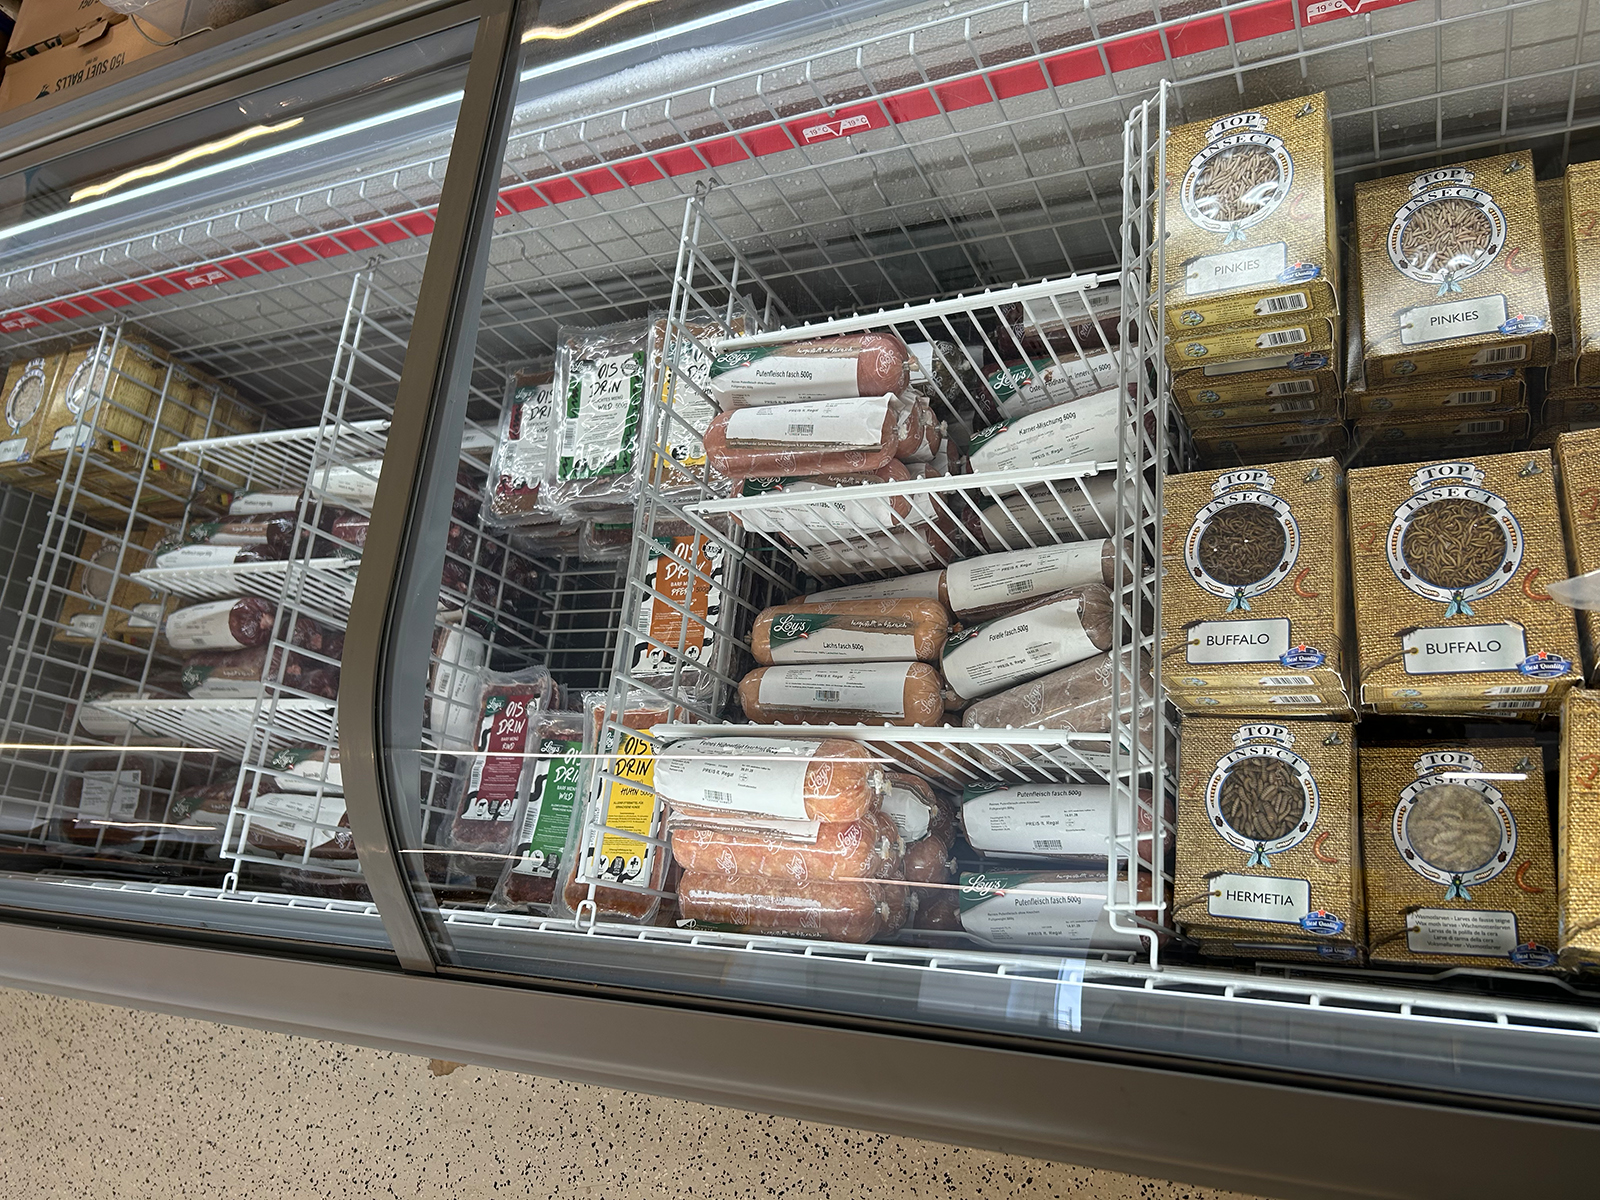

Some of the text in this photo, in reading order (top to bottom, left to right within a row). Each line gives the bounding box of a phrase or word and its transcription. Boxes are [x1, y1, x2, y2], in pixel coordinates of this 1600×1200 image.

[85, 58, 109, 80] SUET
[109, 51, 126, 71] 150
[54, 69, 85, 93] BALLS
[1217, 115, 1257, 131] TOP
[1199, 133, 1276, 161] INSECT
[1419, 168, 1462, 184] TOP
[1403, 188, 1486, 213] INSECT
[1214, 259, 1260, 277] PINKIES
[1430, 310, 1480, 327] PINKIES
[598, 362, 618, 379] OIS
[1222, 470, 1265, 485] TOP
[1420, 465, 1471, 480] TOP
[1205, 492, 1284, 514] INSECT
[1403, 487, 1498, 512] INSECT
[773, 613, 806, 637] Loy's
[1206, 632, 1270, 647] BUFFALO
[1426, 639, 1502, 656] BUFFALO
[1539, 661, 1565, 672] Quality
[506, 701, 524, 718] OIS
[496, 719, 526, 736] DRIN
[1243, 726, 1284, 738] TOP
[624, 736, 648, 755] OIS
[1226, 746, 1303, 767] INSECT
[1425, 753, 1470, 765] TOP
[615, 758, 653, 777] DRIN
[1409, 771, 1494, 794] INSECT
[558, 792, 574, 801] WILD
[620, 787, 639, 796] HUHN
[1017, 790, 1051, 798] Putenfleisch
[1068, 789, 1082, 797] 500g
[962, 873, 1003, 897] Loy's
[1014, 897, 1050, 907] Putenfleisch
[1067, 895, 1082, 905] 500g
[1226, 889, 1295, 906] HERMETIA
